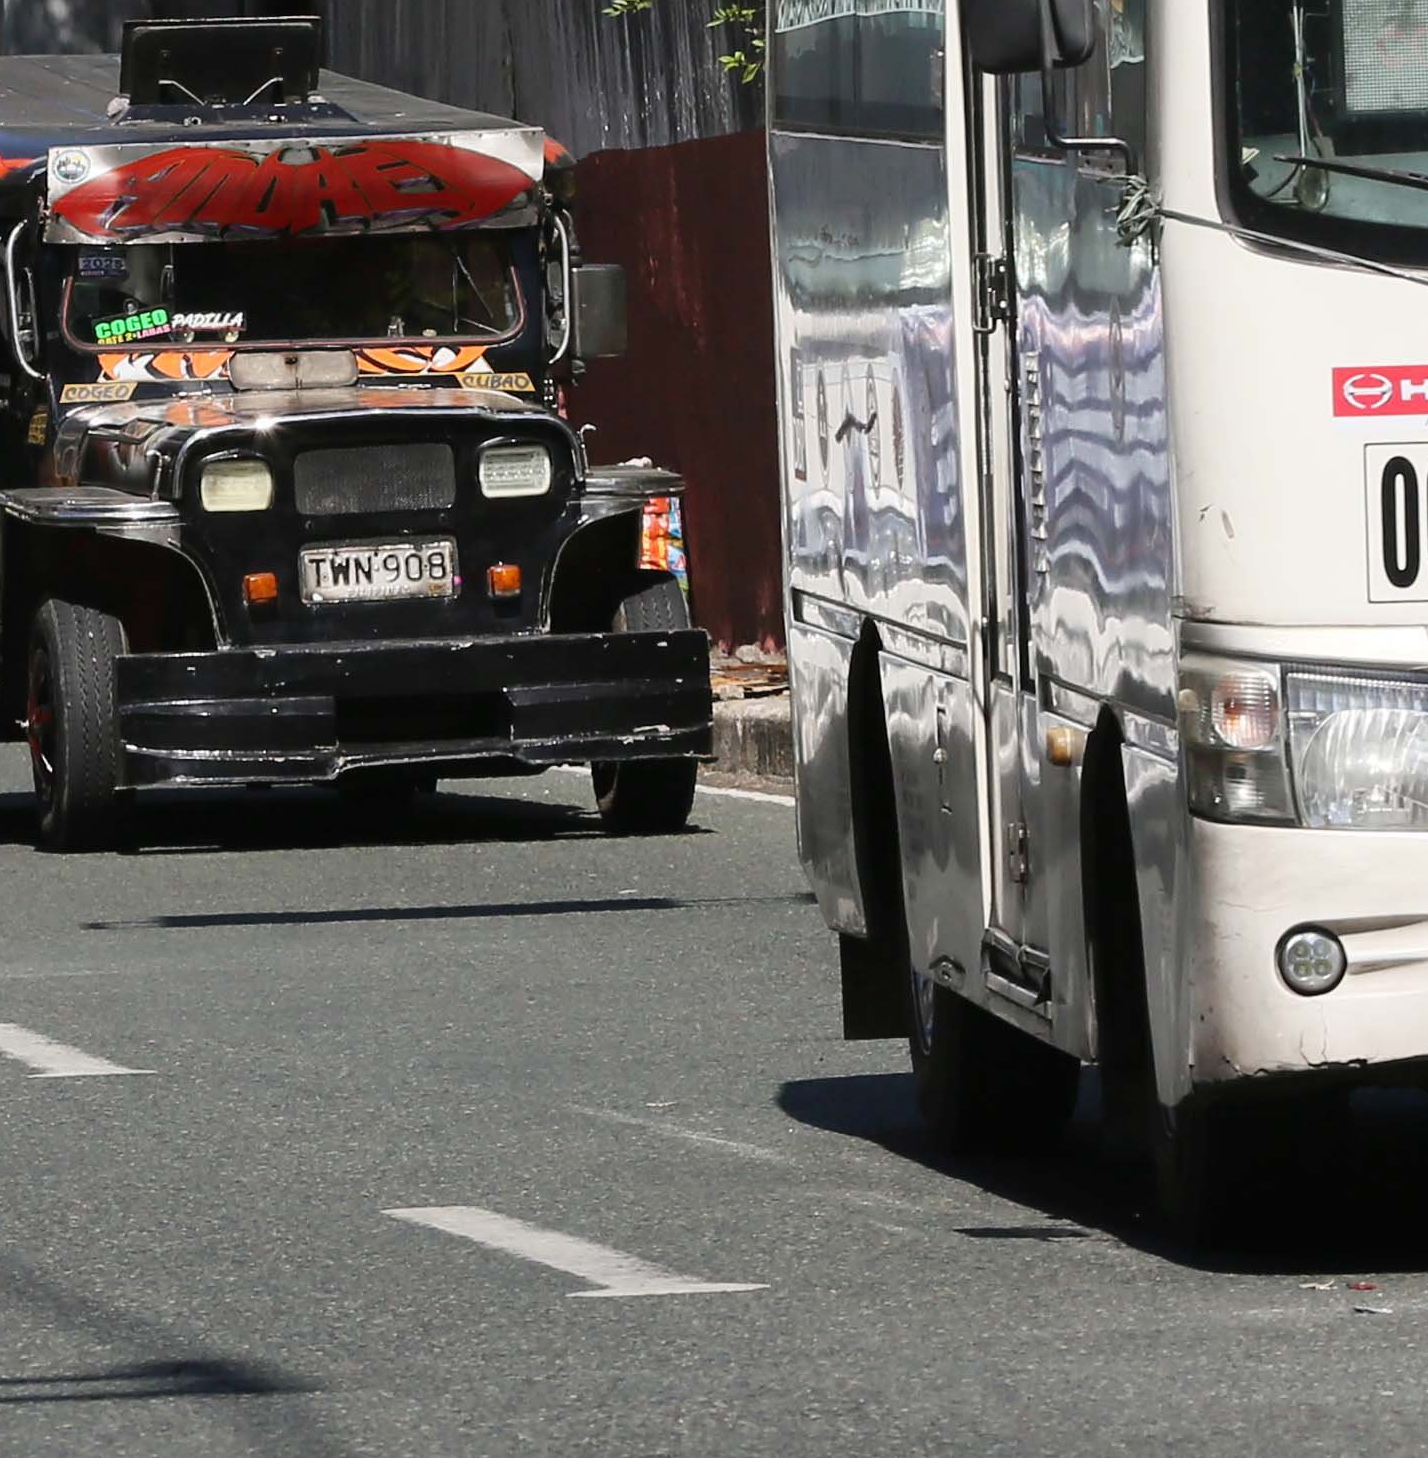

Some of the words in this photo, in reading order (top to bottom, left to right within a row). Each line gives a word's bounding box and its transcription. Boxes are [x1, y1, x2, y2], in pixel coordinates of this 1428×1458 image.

[95, 309, 168, 339] COGEO
[171, 312, 244, 329] PADILLA
[462, 374, 530, 390] CUBAO
[65, 384, 130, 401] COGEO
[308, 555, 373, 588] TWN
[382, 551, 447, 583] 908
